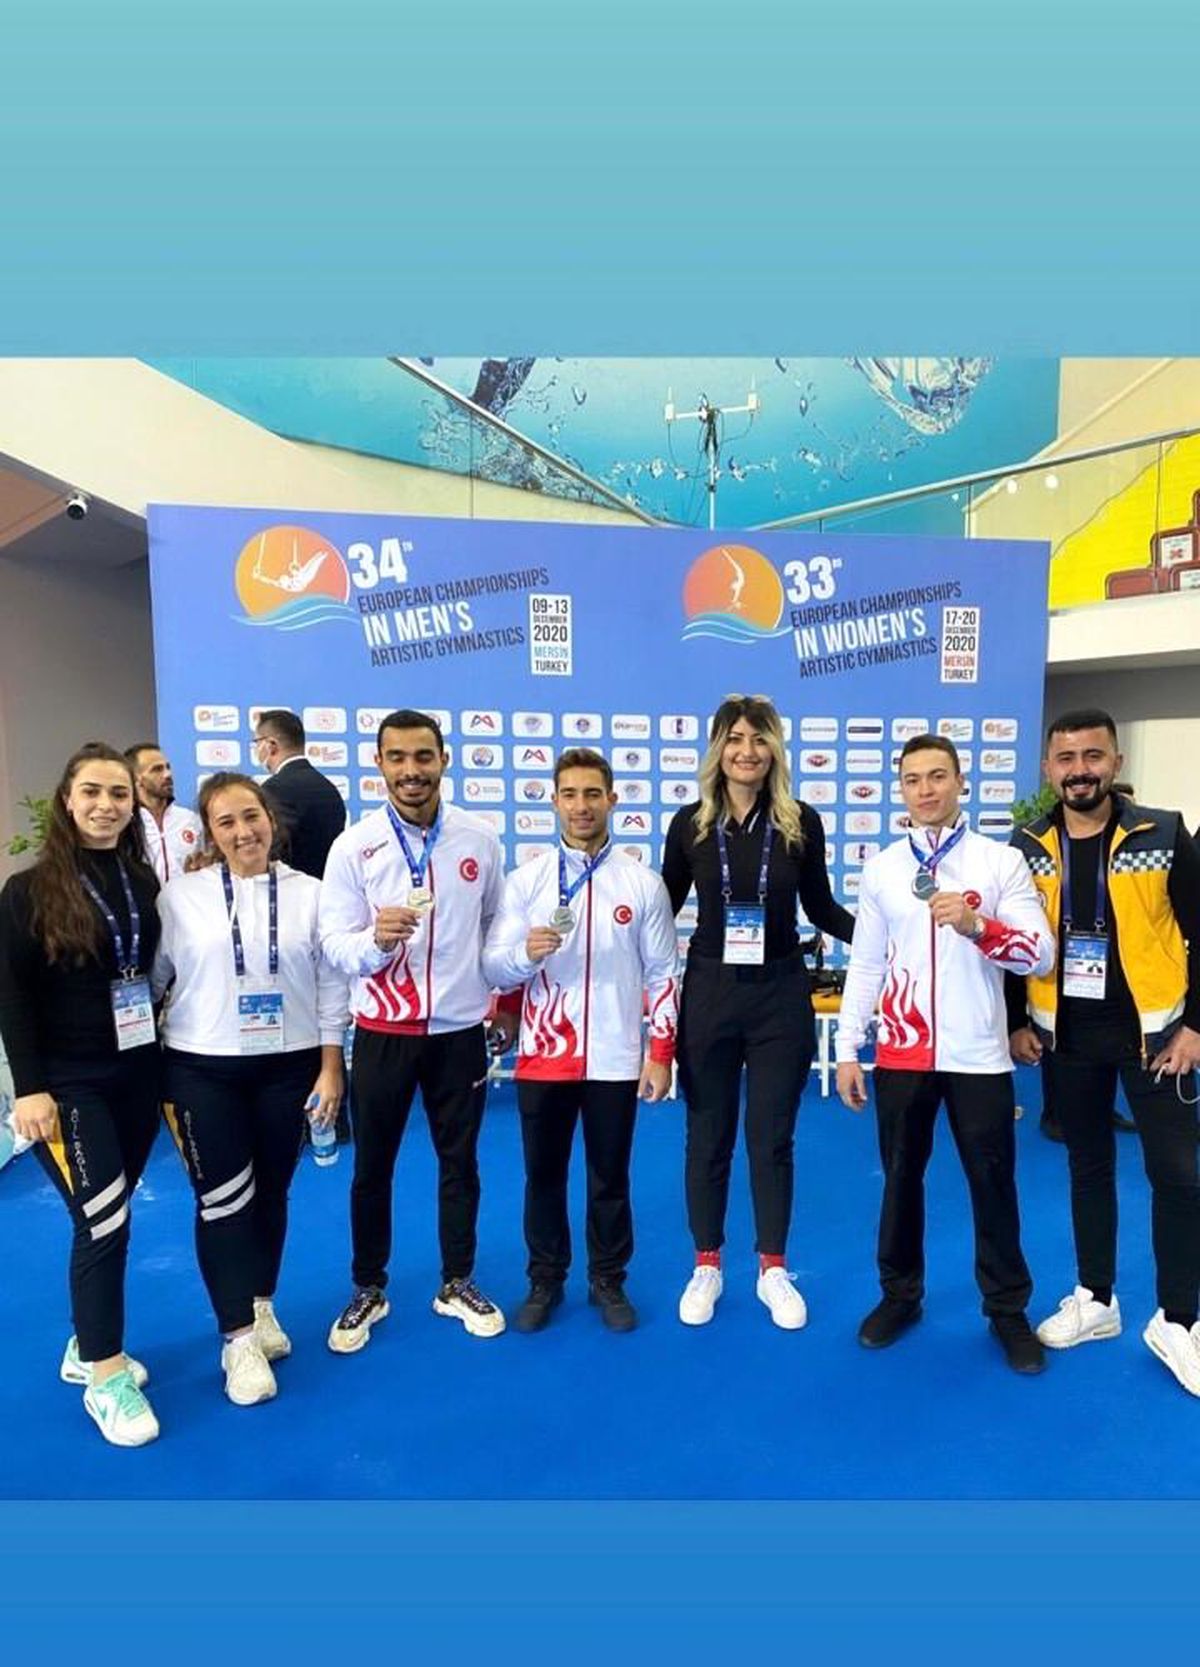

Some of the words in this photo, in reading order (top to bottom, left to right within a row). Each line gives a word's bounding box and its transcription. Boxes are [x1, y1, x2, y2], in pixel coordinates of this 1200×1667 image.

[358, 586, 433, 614] EUROPEAN
[436, 568, 550, 602] CHAMPIONSHIPS
[791, 599, 858, 628] EUROPEAN
[860, 582, 962, 614] CHAMPIONSHIPS
[363, 612, 391, 648] IN
[395, 601, 474, 644] MEN'S
[534, 625, 567, 642] 2020
[795, 628, 819, 659] IN
[822, 609, 926, 655] WOMEN'S
[945, 636, 976, 651] 2020
[371, 641, 433, 668] ARTISTIC
[436, 626, 525, 657] GYMNASTICS
[535, 660, 568, 672] TURKEY
[799, 655, 855, 680] ARTISTIC
[859, 637, 937, 668] GYMNASTICS
